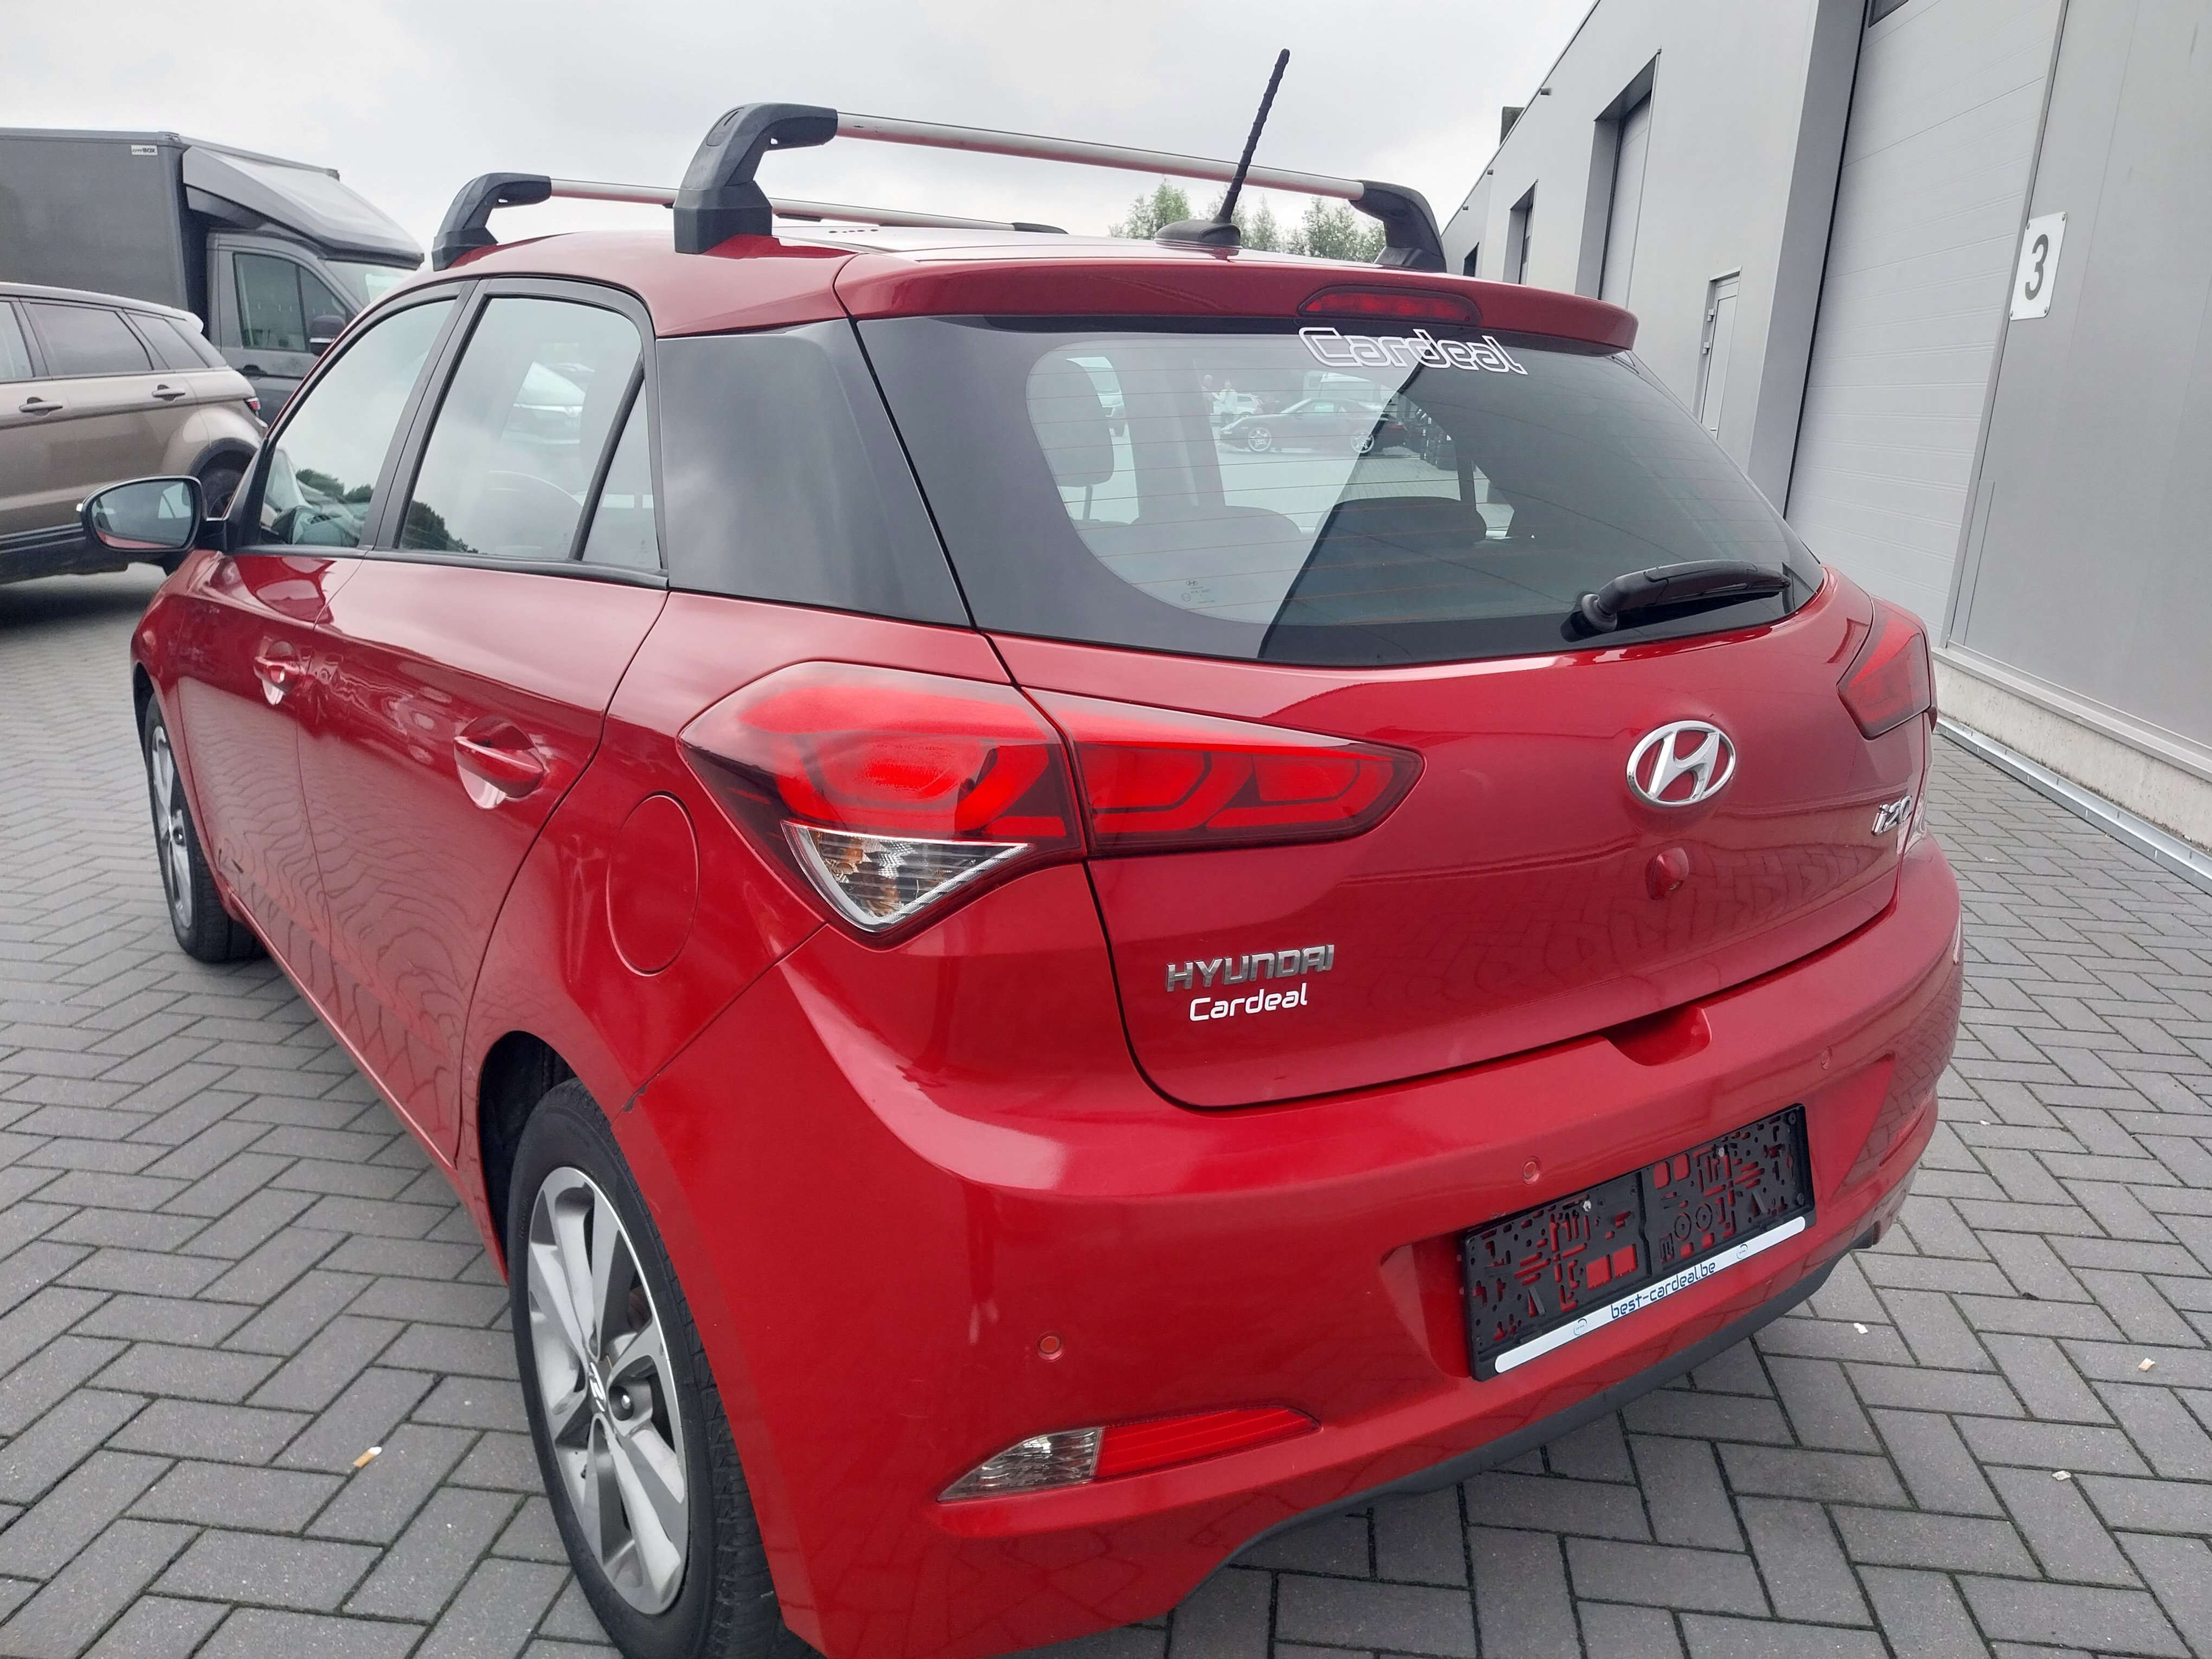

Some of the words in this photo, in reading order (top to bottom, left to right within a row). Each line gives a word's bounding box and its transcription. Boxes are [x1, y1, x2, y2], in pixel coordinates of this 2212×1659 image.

[2025, 234, 2049, 301] 3
[1298, 327, 1528, 375] Cardeal
[1871, 795, 1912, 835] i20
[1165, 944, 1335, 992] HYUNDAI
[1189, 982, 1308, 1021] Cardeal
[1611, 1262, 1716, 1319] best-cardeal.be
